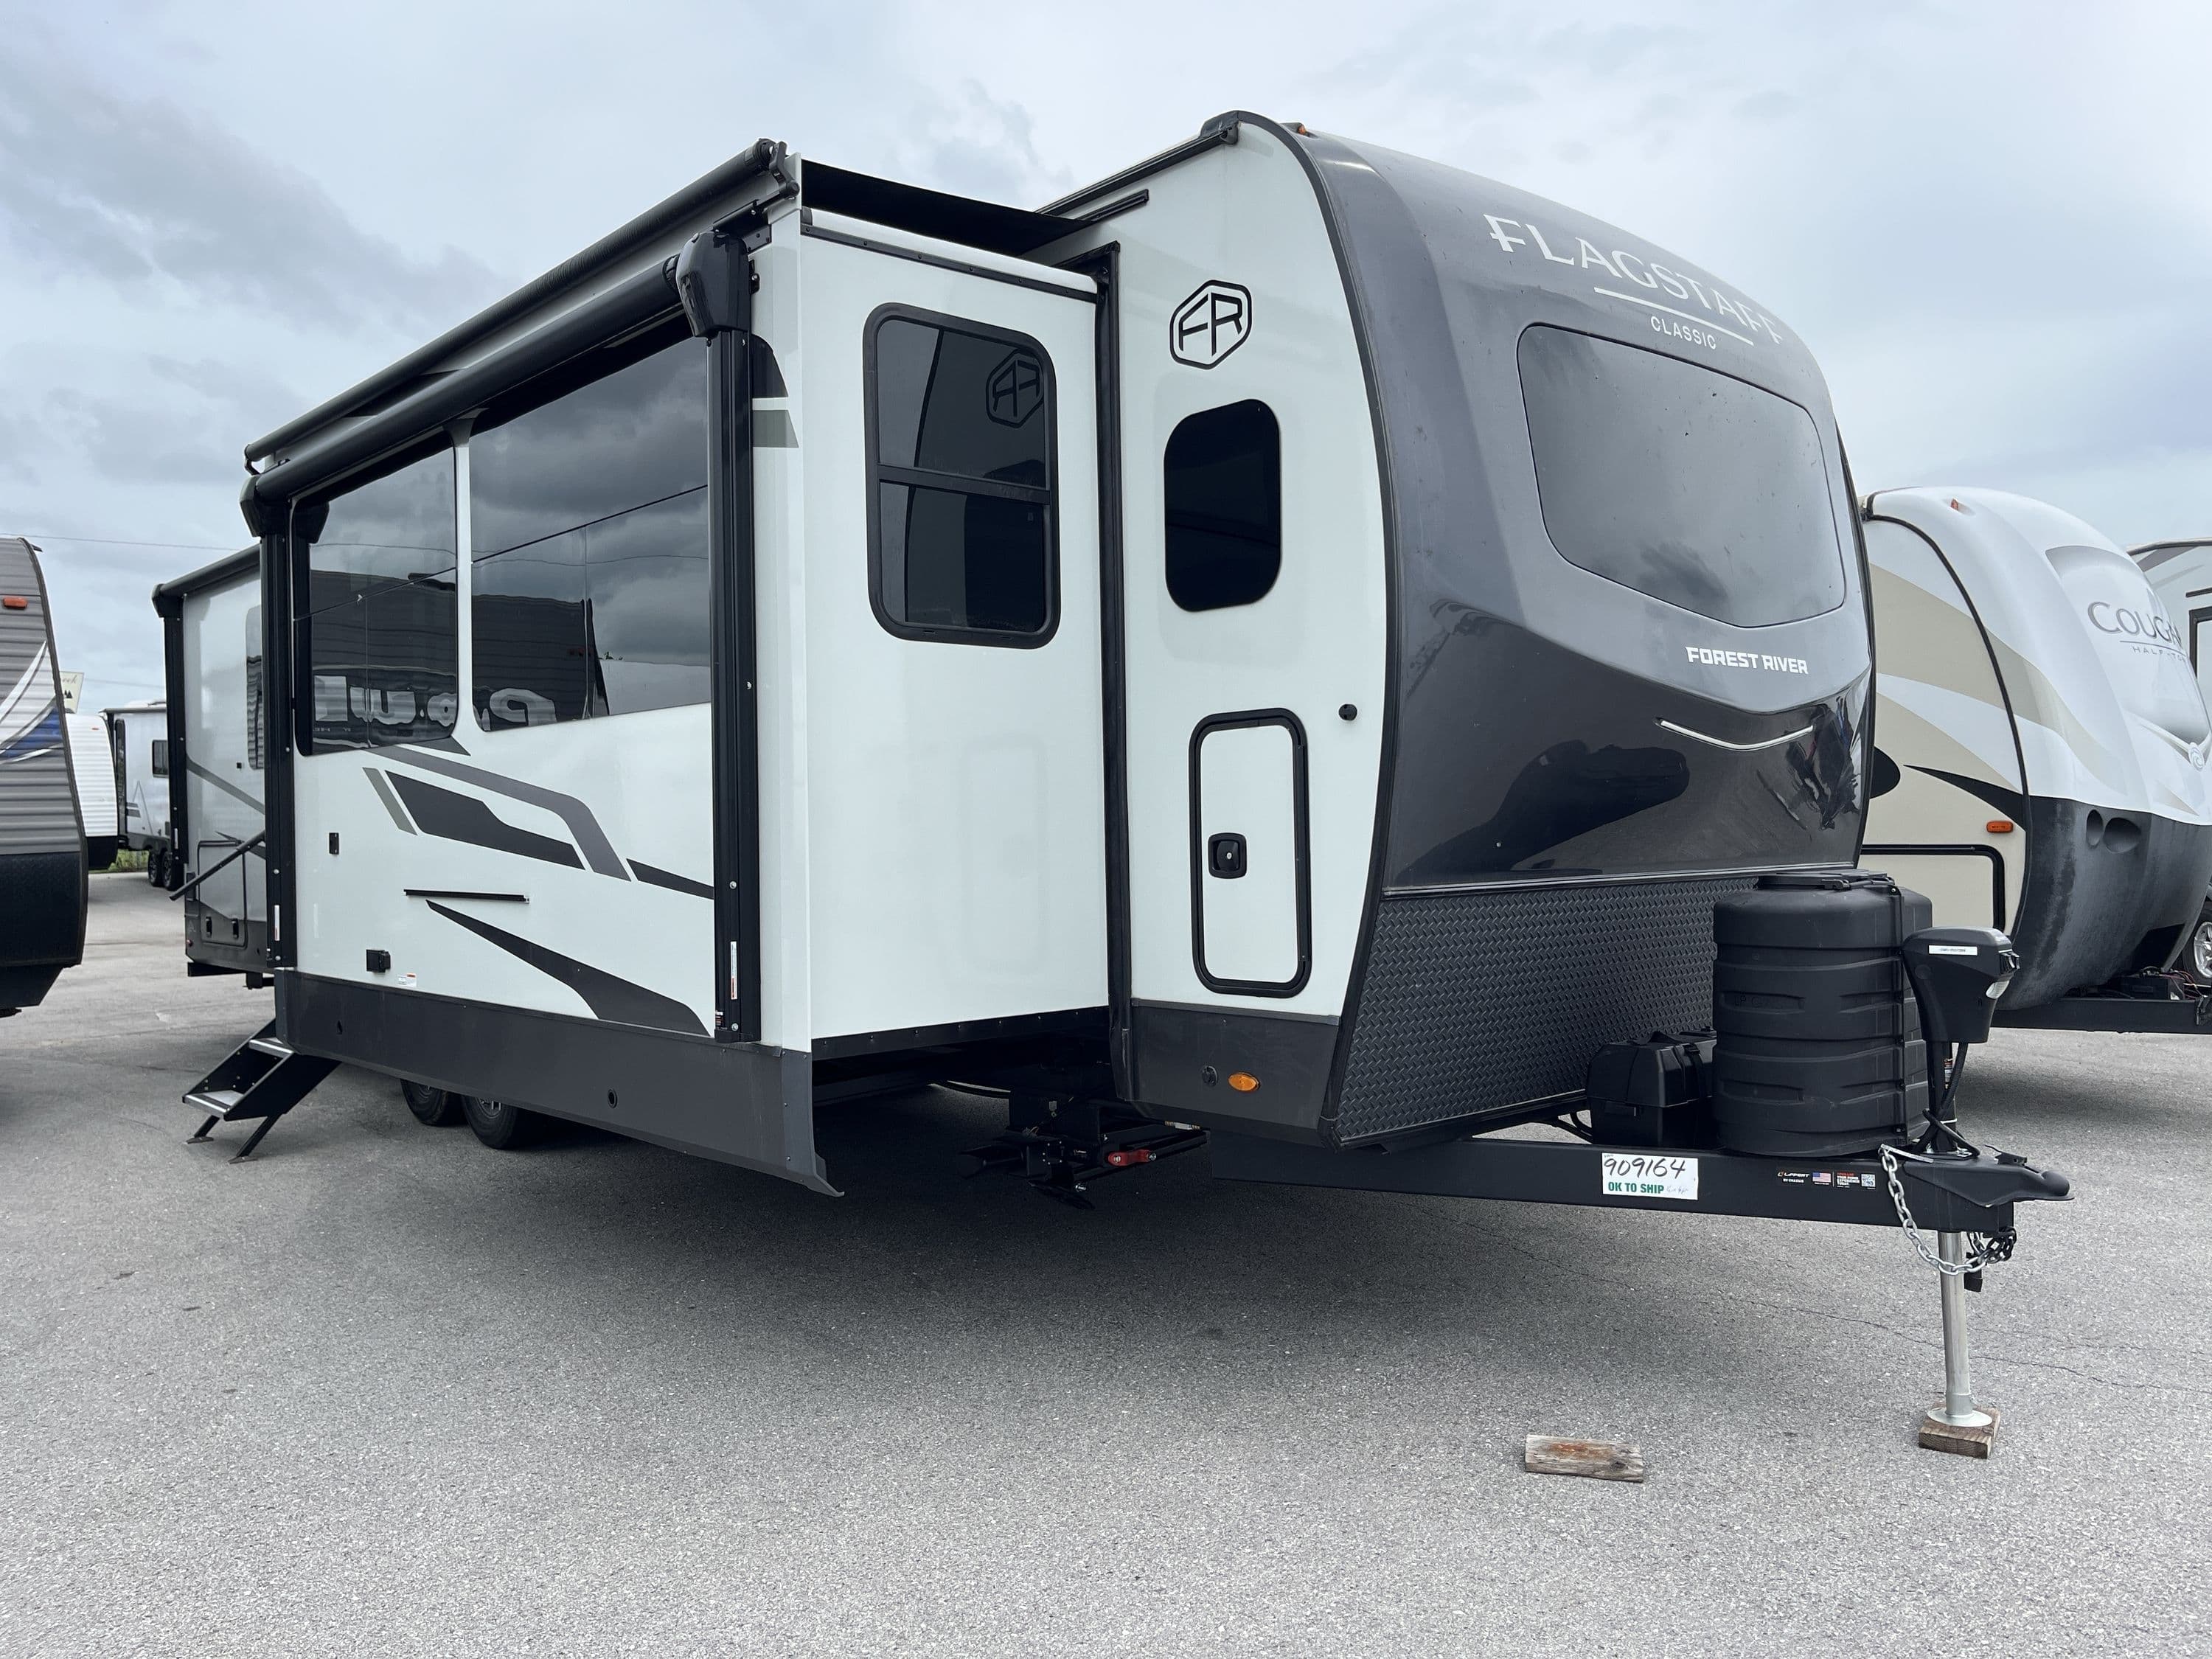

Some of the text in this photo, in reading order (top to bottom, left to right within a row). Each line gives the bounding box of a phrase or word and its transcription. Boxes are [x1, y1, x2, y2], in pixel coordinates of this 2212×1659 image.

[1484, 214, 1783, 344] FLAGSTAFF
[1650, 315, 1717, 350] CLASSIC
[1685, 646, 1809, 675] FOREST RIVER
[1604, 1157, 1686, 1180] 909164
[1608, 1181, 1622, 1192] OK
[1624, 1183, 1637, 1192] TO
[1640, 1183, 1664, 1194] SHIP
